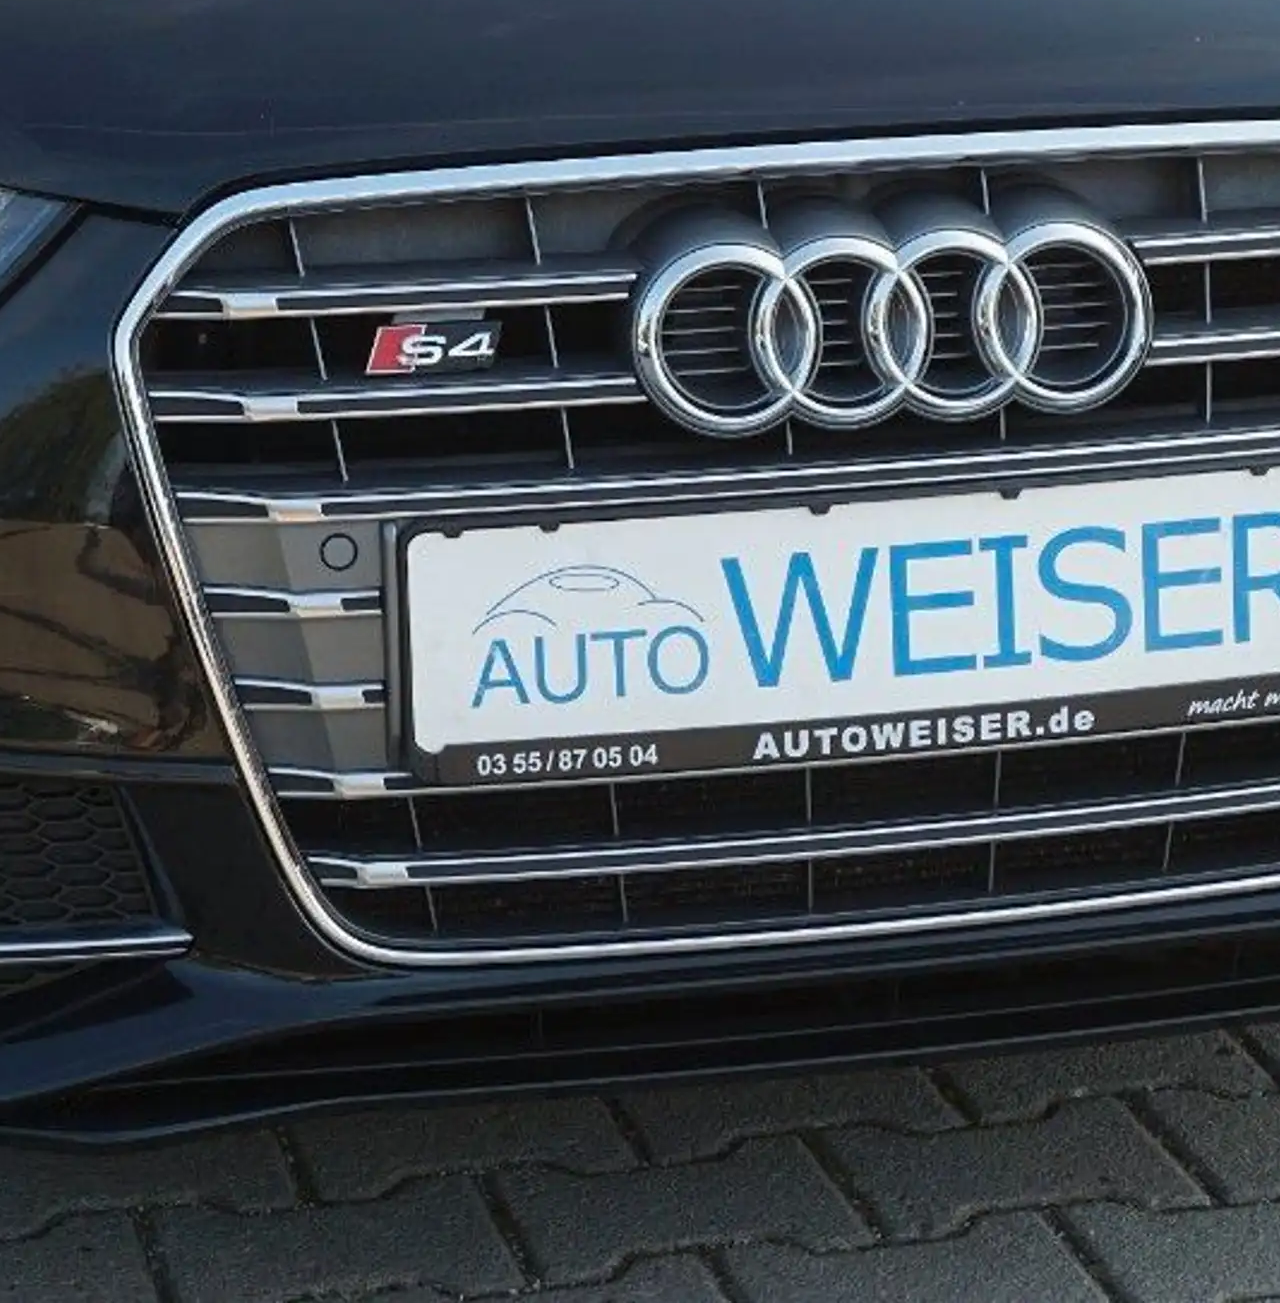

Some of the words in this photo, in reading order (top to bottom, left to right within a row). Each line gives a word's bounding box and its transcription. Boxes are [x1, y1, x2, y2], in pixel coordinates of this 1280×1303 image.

[396, 331, 495, 366] S4
[471, 625, 710, 708] AUTO
[1187, 688, 1261, 717] macht
[752, 705, 1096, 760] AUTOWEISER.de
[476, 753, 507, 776] 03
[592, 746, 622, 768] 05
[629, 743, 659, 766] 04
